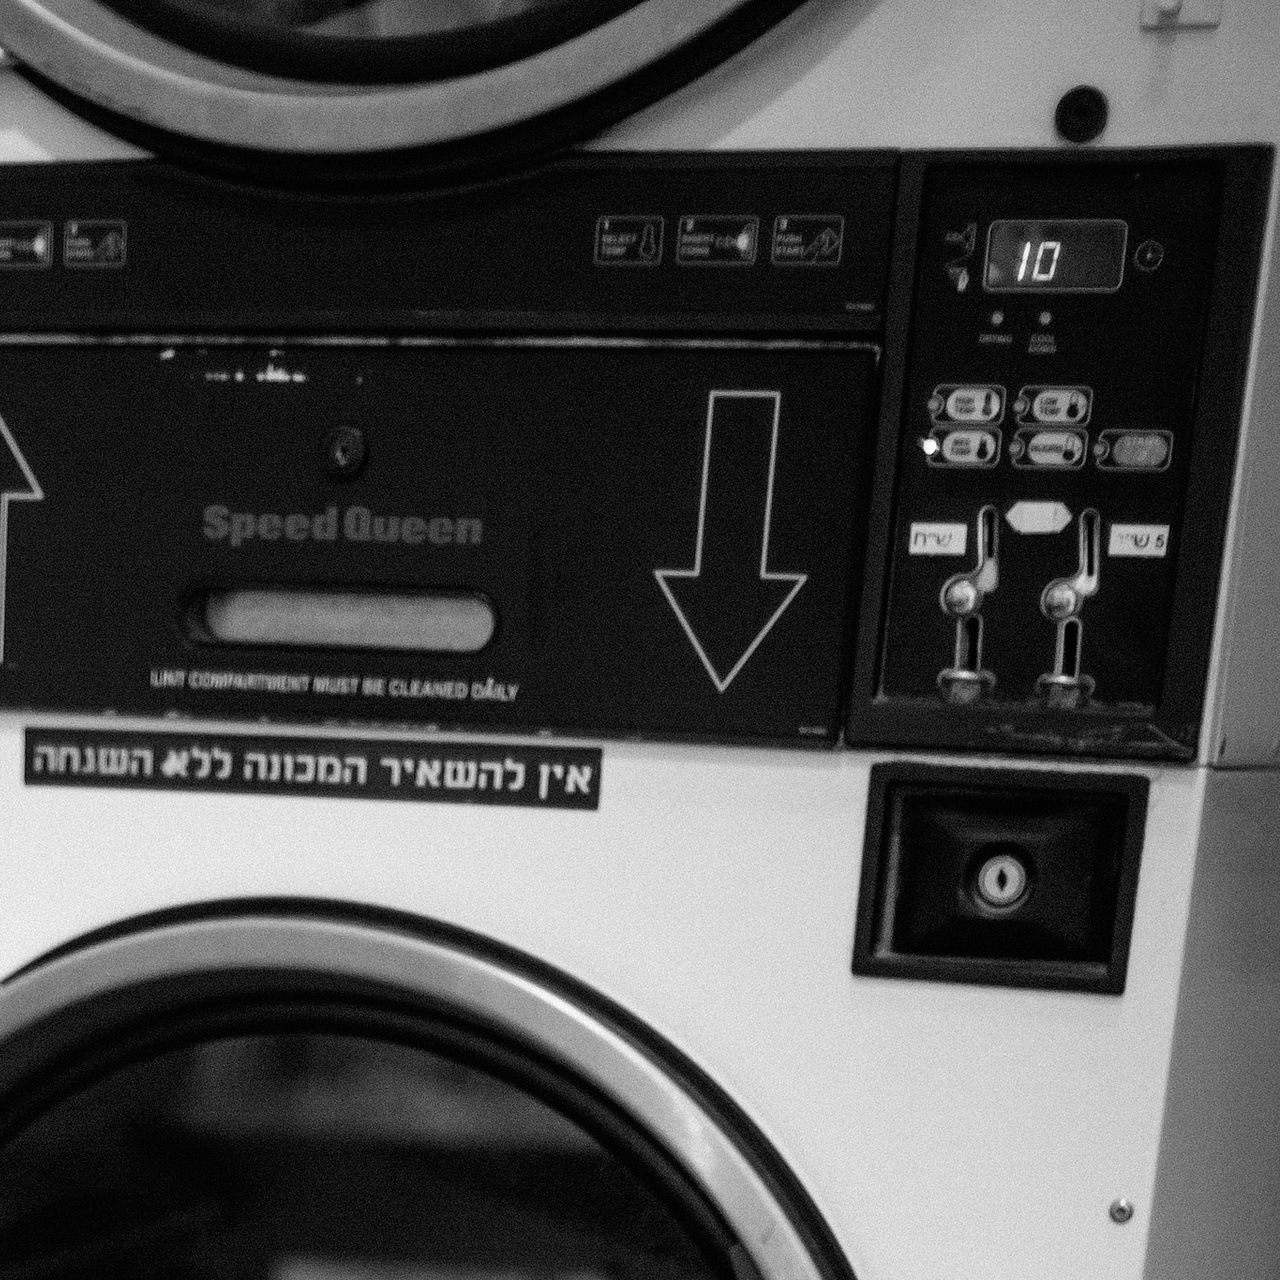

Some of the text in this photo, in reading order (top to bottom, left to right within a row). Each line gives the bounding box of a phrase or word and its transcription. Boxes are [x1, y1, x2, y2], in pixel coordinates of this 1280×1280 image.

[1016, 240, 1062, 283] 10
[203, 503, 483, 547] Speed Queen
[312, 675, 359, 696] MUST
[387, 678, 469, 700] CLEANED
[159, 745, 234, 781] ללא
[242, 752, 368, 785] המכונה
[380, 757, 526, 792] להשאיר
[538, 763, 593, 801] אין
